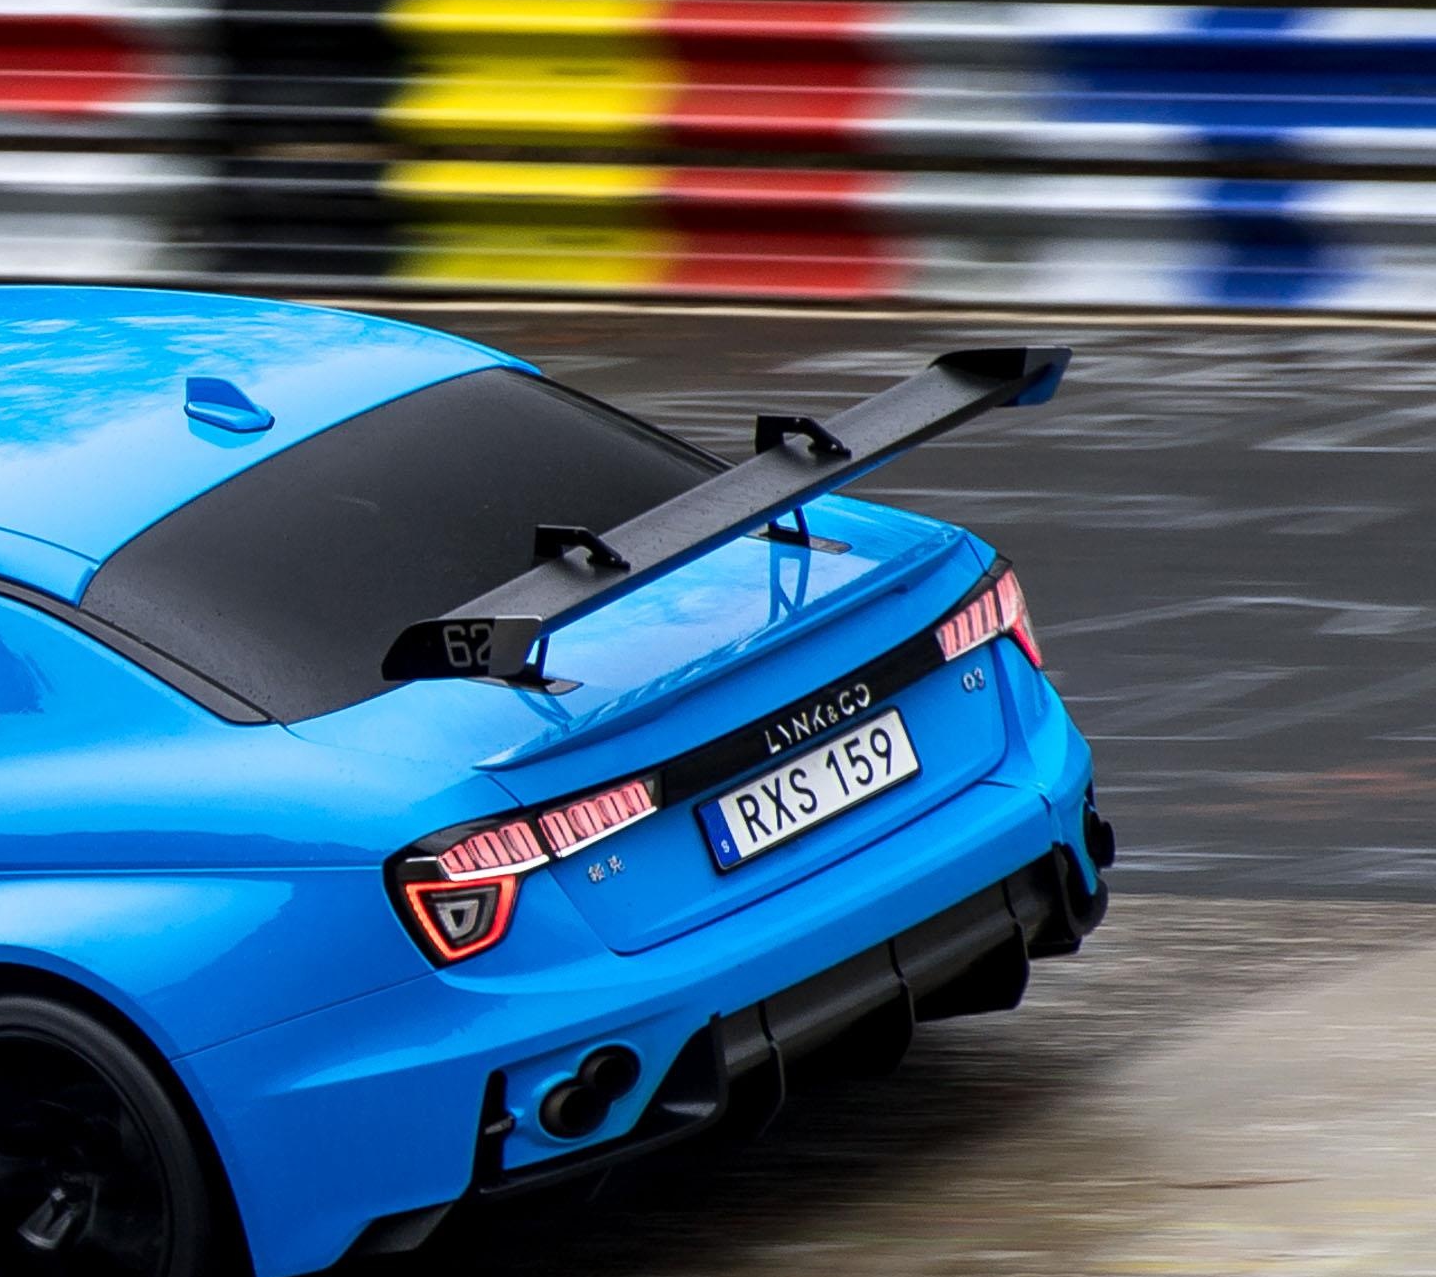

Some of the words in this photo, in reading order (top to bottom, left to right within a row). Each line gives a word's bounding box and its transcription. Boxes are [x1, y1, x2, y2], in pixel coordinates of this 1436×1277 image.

[443, 623, 493, 667] 62
[963, 667, 984, 691] 03
[735, 767, 818, 844] RXS
[825, 727, 893, 797] 159
